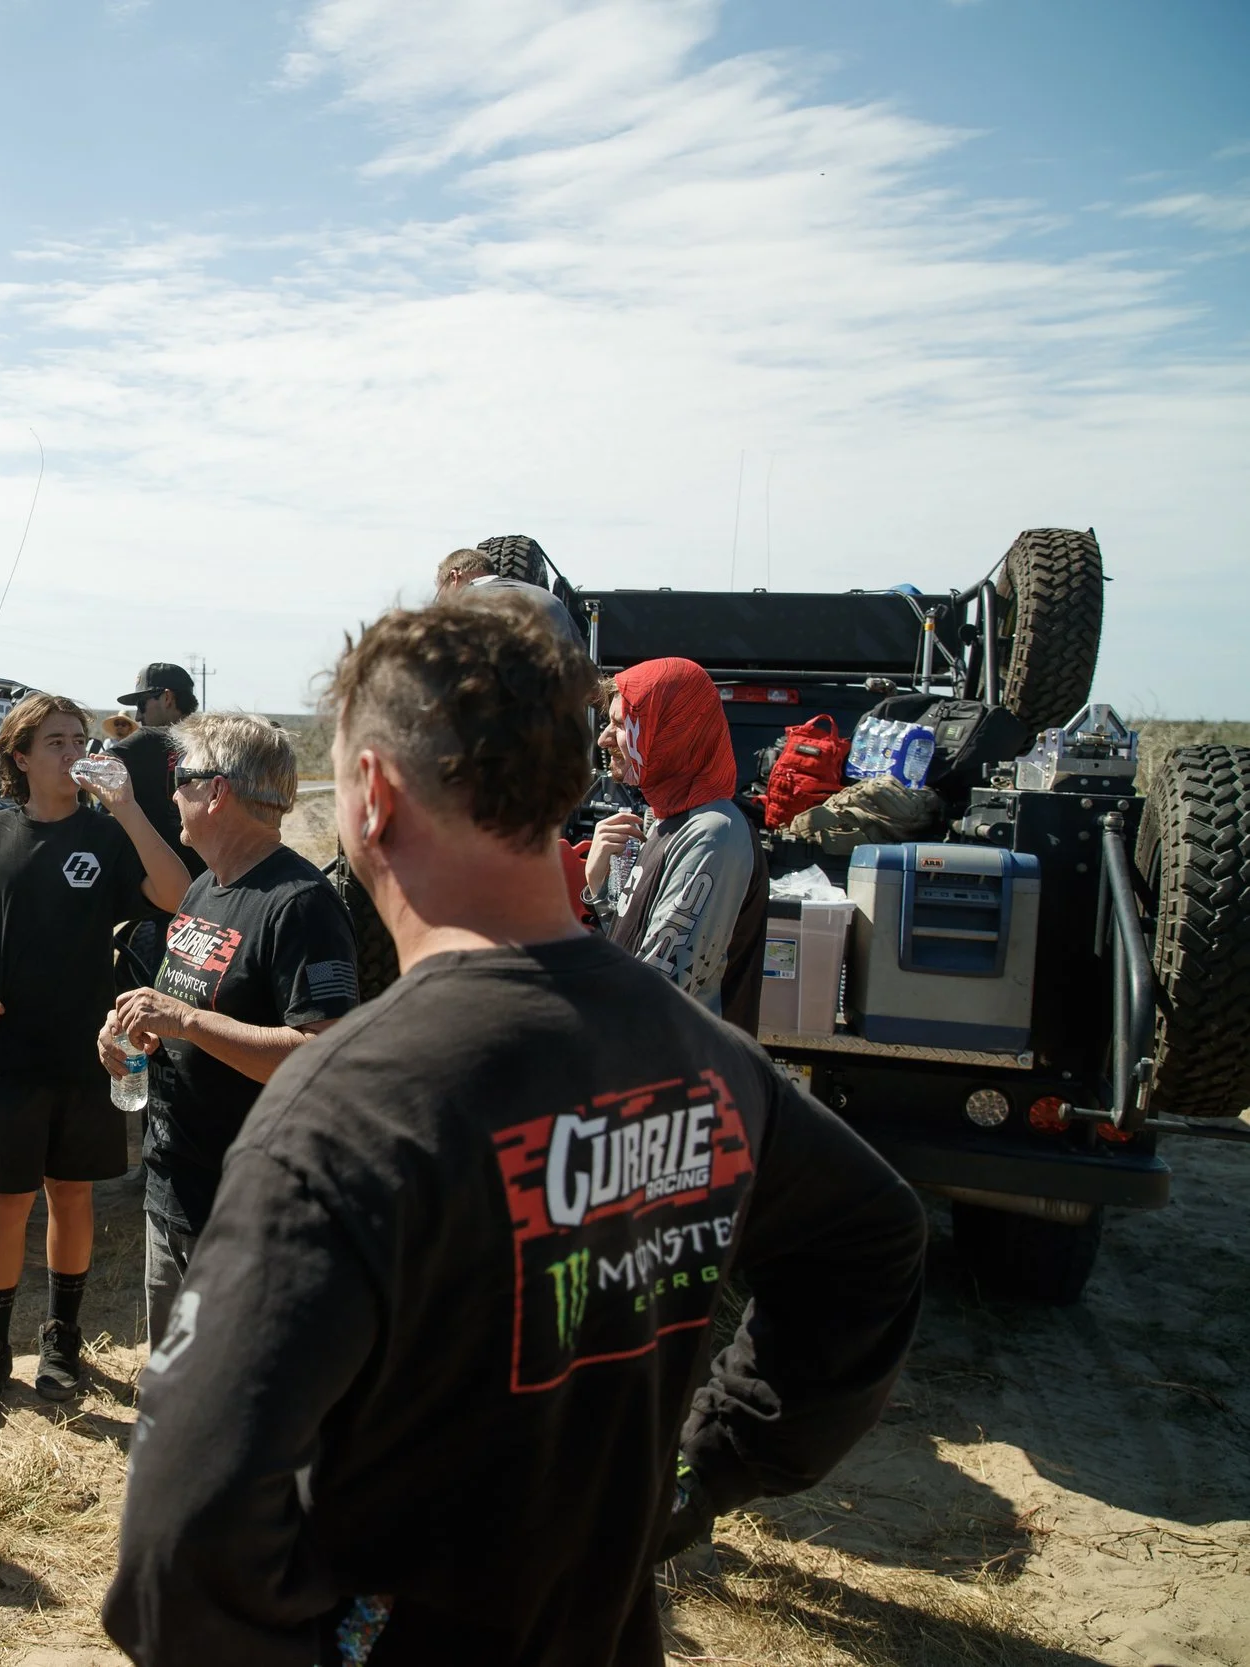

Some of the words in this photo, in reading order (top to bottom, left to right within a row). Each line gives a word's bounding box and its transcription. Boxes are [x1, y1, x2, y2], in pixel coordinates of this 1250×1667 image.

[164, 966, 209, 997] MONSTER
[546, 1103, 715, 1226] CURRIE
[645, 1167, 710, 1201] RACING
[597, 1211, 739, 1290] MONSTE
[634, 1265, 720, 1312] EERG
